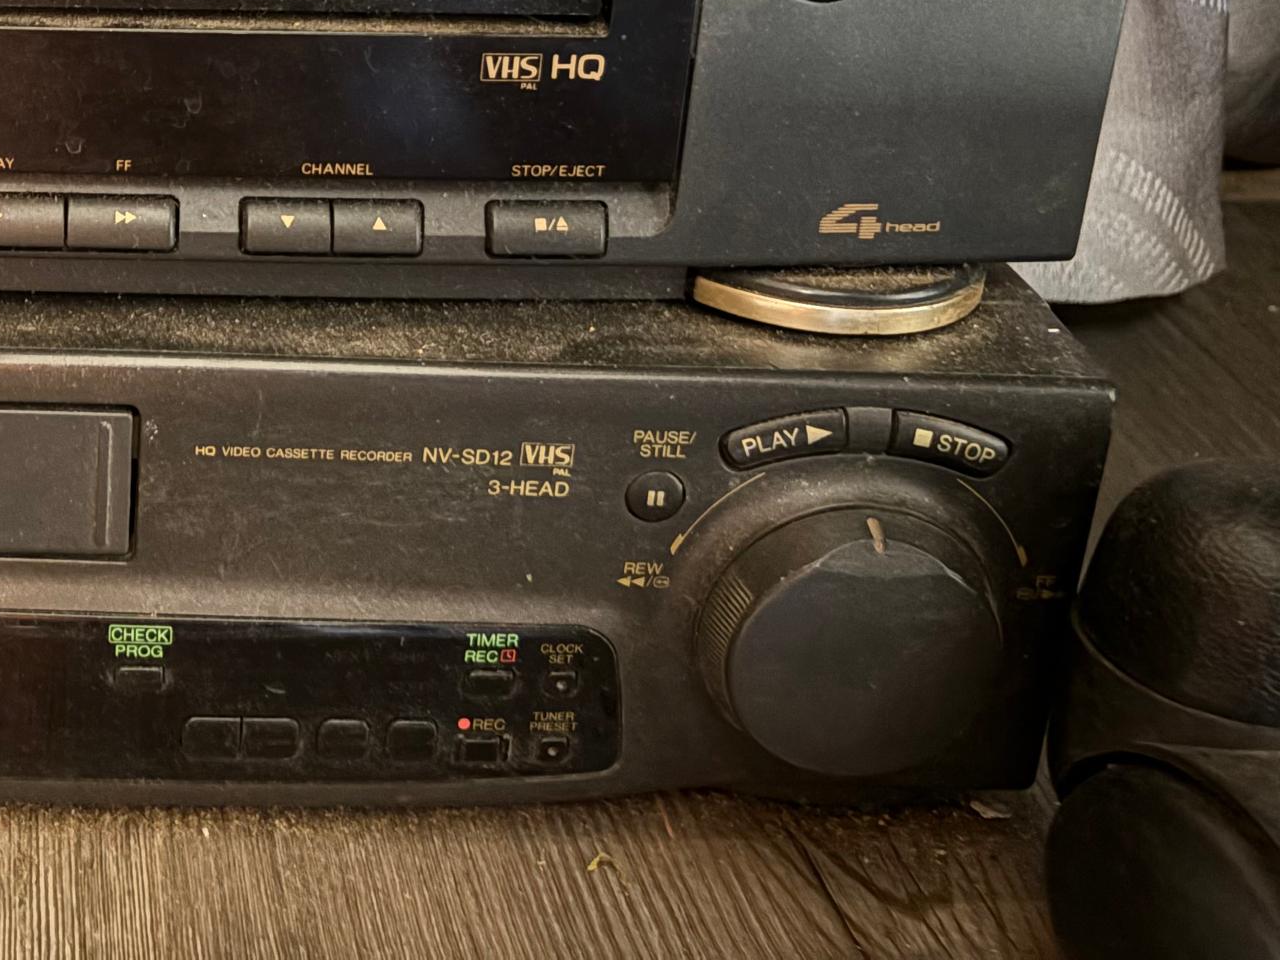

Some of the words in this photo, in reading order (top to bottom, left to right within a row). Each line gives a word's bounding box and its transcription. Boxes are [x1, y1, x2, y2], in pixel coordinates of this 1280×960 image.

[484, 54, 541, 80] VHS
[551, 53, 606, 81] HQ
[520, 82, 538, 90] PAL
[116, 160, 132, 172] FF
[301, 162, 374, 176] CHANNEL
[511, 164, 606, 178] STOP/EJECT
[885, 220, 941, 233] head
[633, 429, 697, 446] PAUSE/
[741, 427, 800, 457] PLAY
[195, 445, 216, 456] HQ
[222, 445, 261, 458] VIDEO
[266, 447, 335, 460] CASSETTE
[340, 449, 413, 462] RECORDER
[422, 447, 513, 466] NV-SD12
[525, 444, 572, 465] VHS
[639, 443, 687, 459] STILL
[937, 433, 997, 464] STOP
[553, 467, 571, 477] PAL
[487, 479, 570, 497] 3-HEAD
[623, 562, 664, 576] REW
[111, 628, 169, 643] CHECK
[466, 633, 519, 648] TIMER
[115, 644, 163, 658] PROG
[540, 643, 584, 654] CLOCK
[464, 650, 499, 663] REC
[548, 654, 574, 664] SET
[533, 711, 576, 721] TUNER
[472, 718, 506, 731] REC
[529, 721, 579, 732] PRESET
